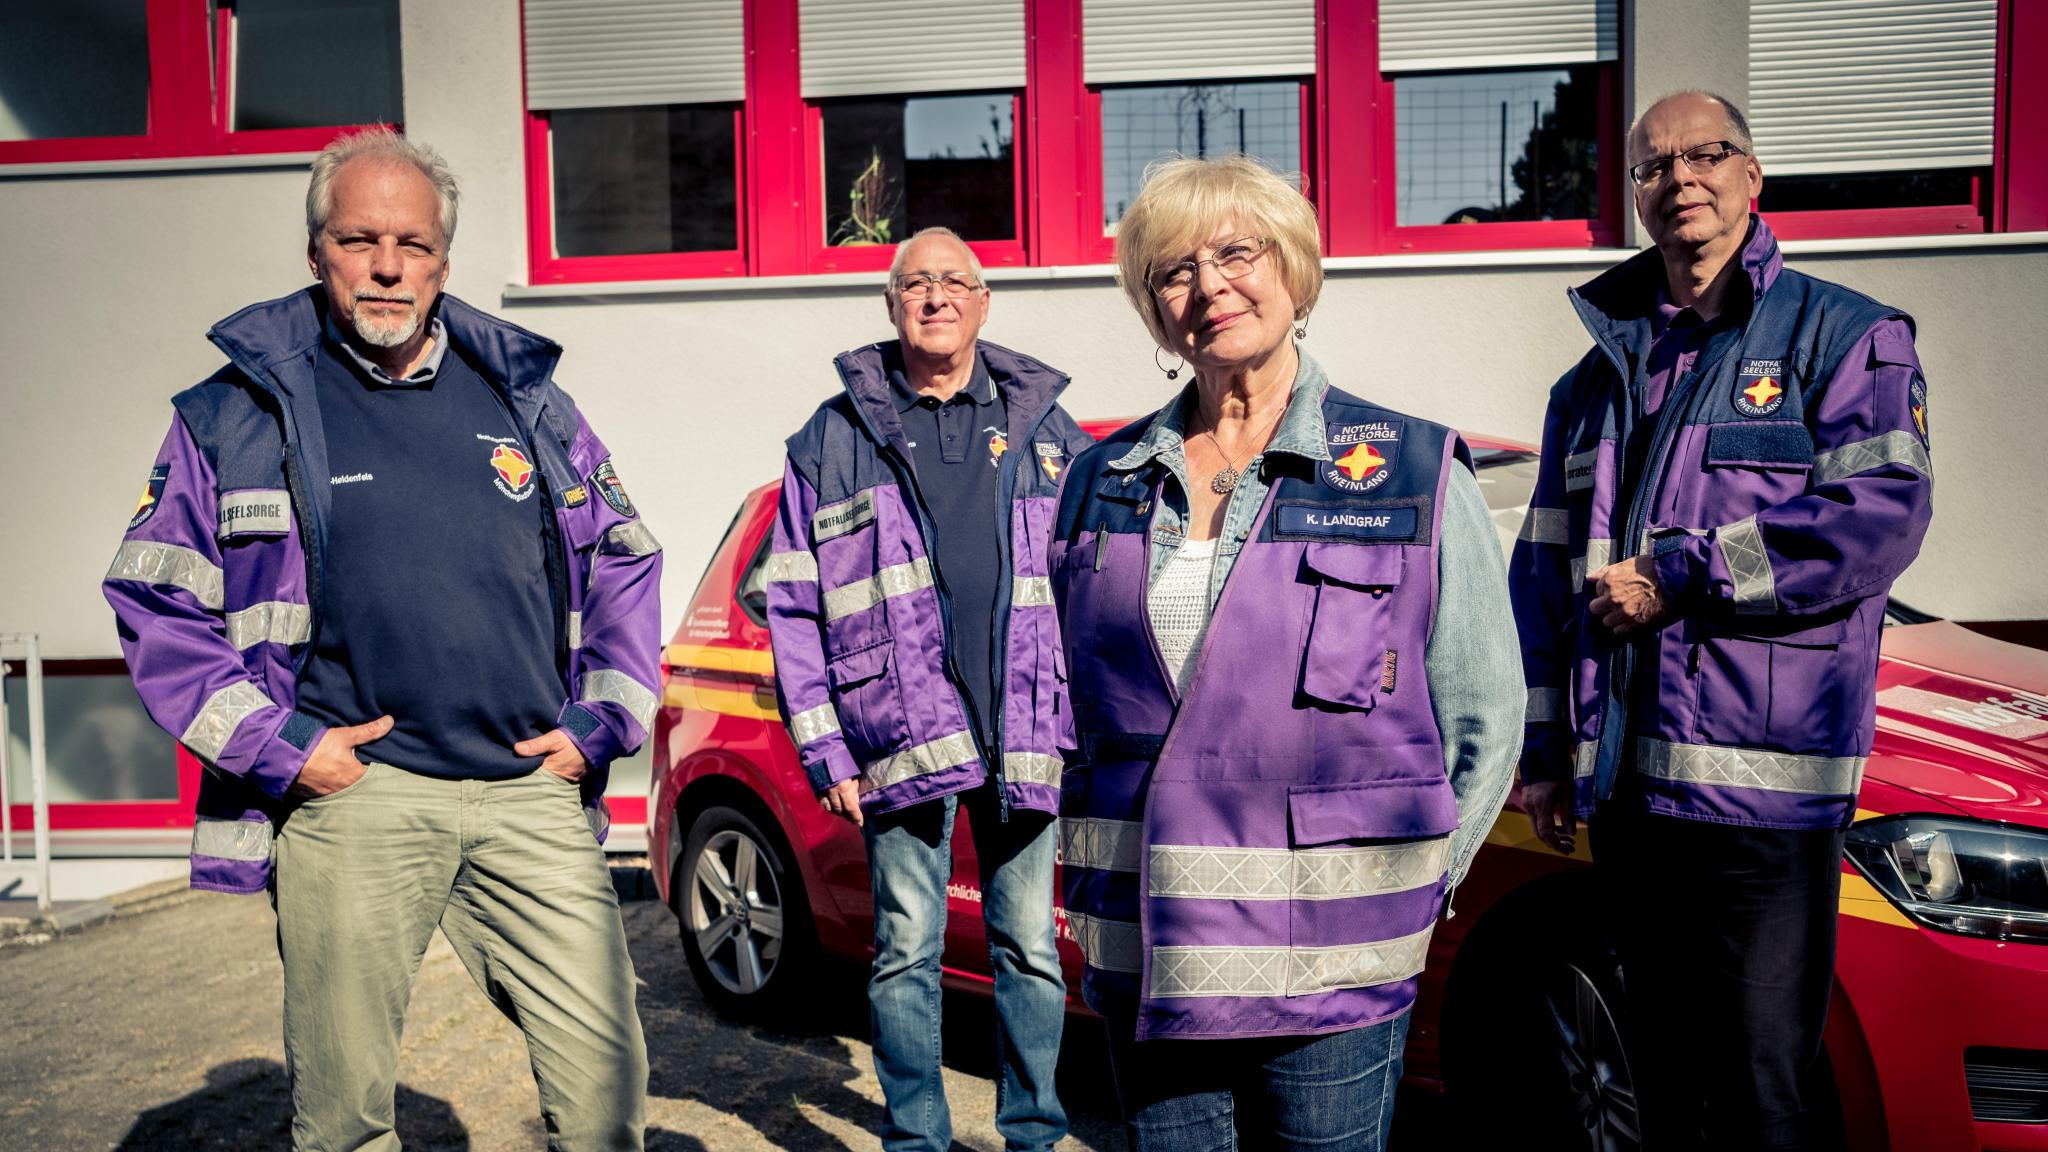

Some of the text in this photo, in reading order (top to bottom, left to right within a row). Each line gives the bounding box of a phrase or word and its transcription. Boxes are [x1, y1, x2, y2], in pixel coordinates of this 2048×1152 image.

[1743, 366, 1785, 375] SEELSOR
[1737, 397, 1783, 414] RHEINLAND
[1342, 422, 1390, 434] NOTFALL
[1333, 430, 1397, 443] SEELSORGE
[1327, 468, 1389, 491] RHEINLAND
[1306, 514, 1391, 527] K. LANDGRAF
